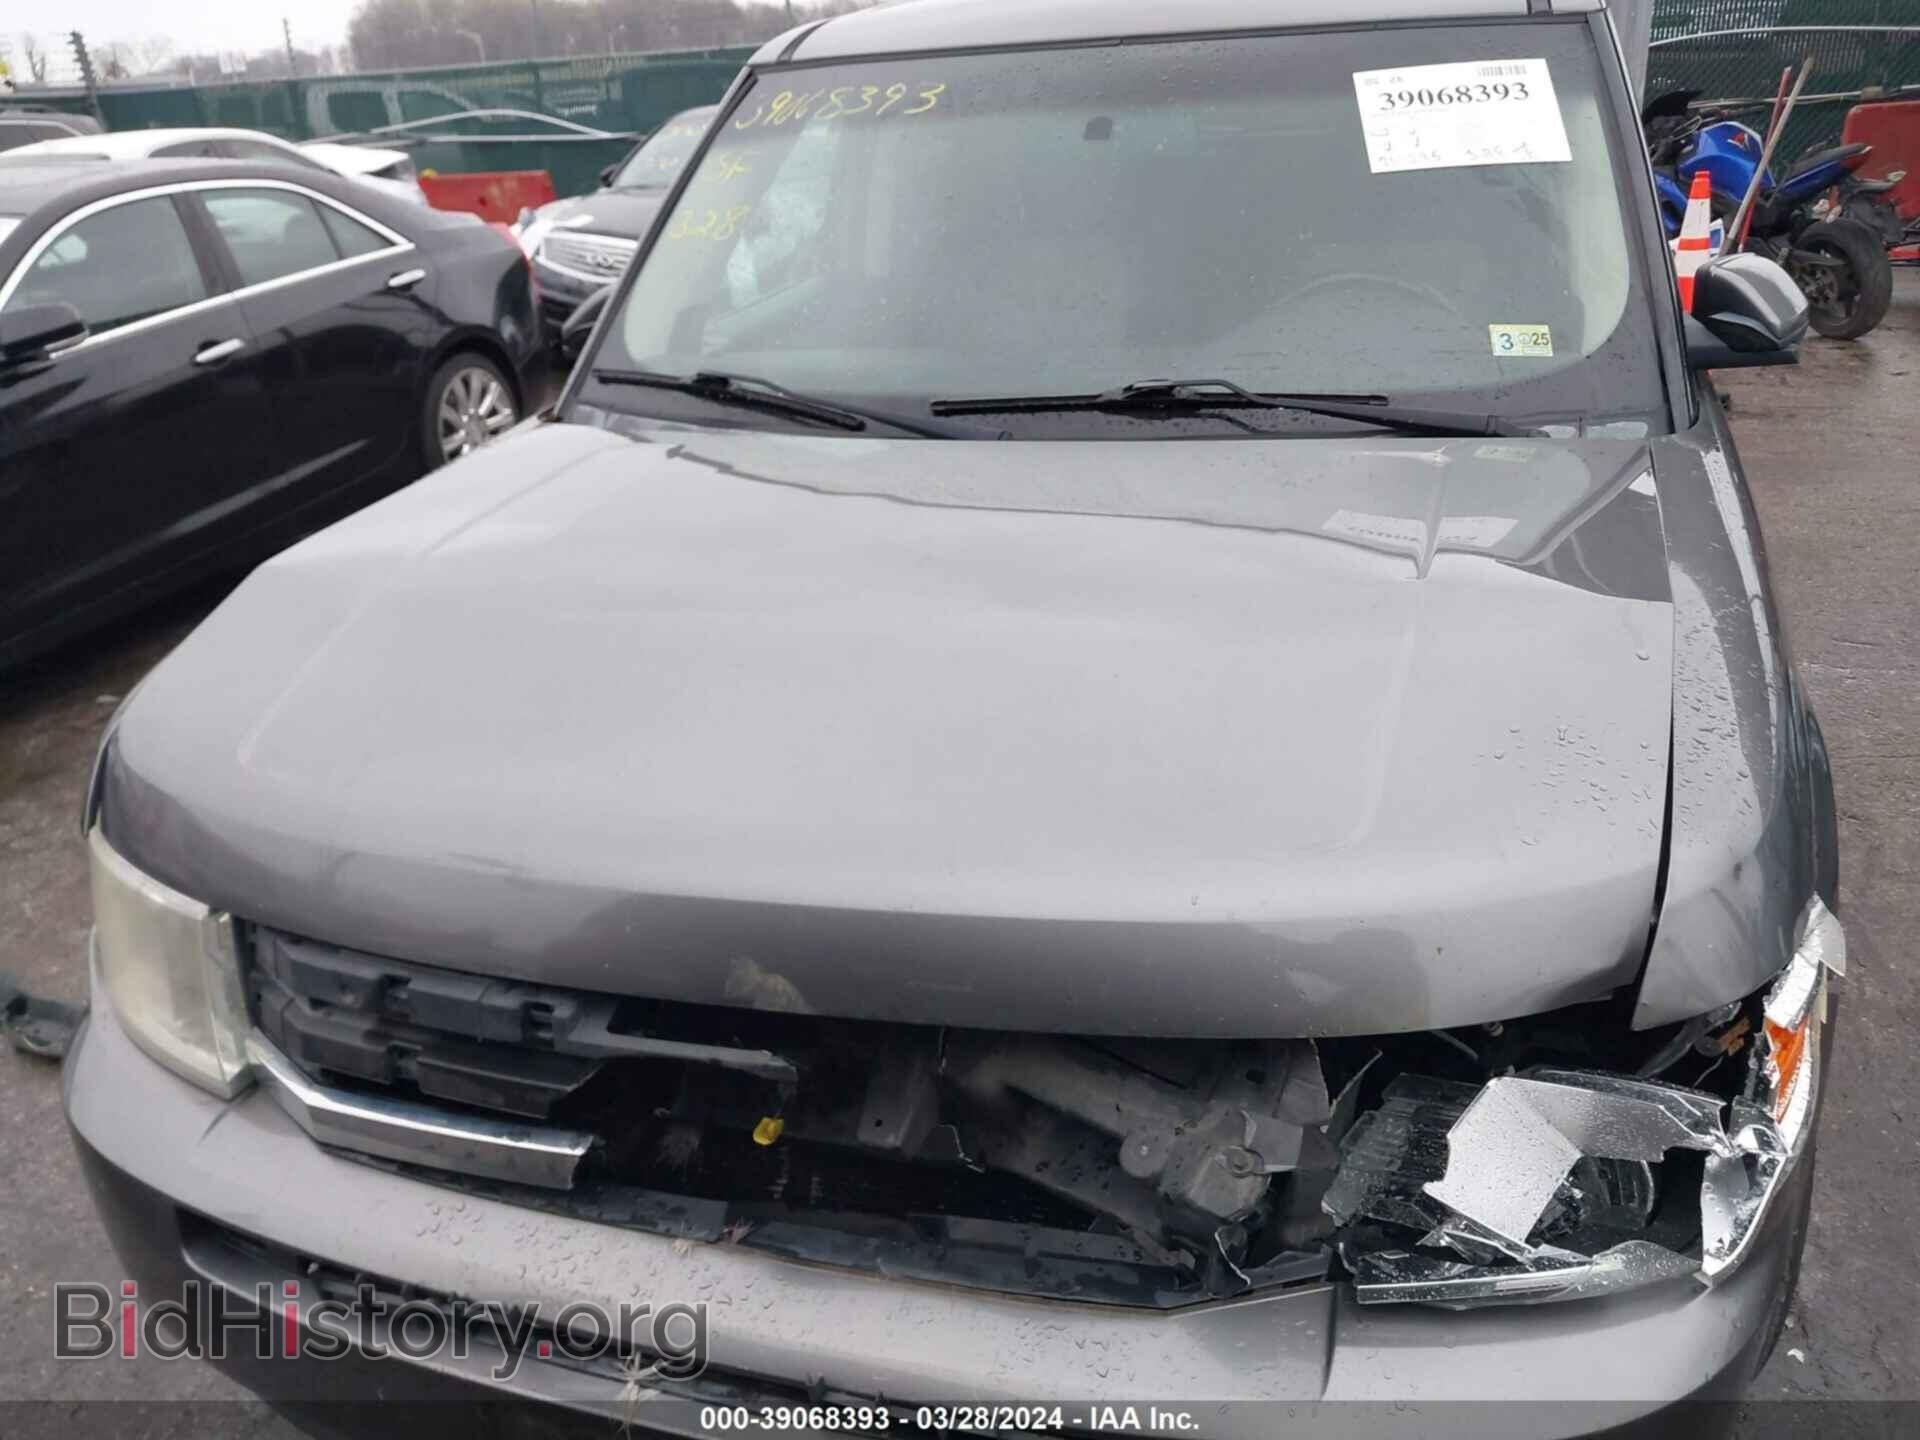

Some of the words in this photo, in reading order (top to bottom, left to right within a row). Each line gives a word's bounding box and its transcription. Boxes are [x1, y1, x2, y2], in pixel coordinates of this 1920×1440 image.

[1379, 80, 1531, 111] 39068393
[1498, 332, 1514, 351] 3
[1531, 332, 1550, 346] 25
